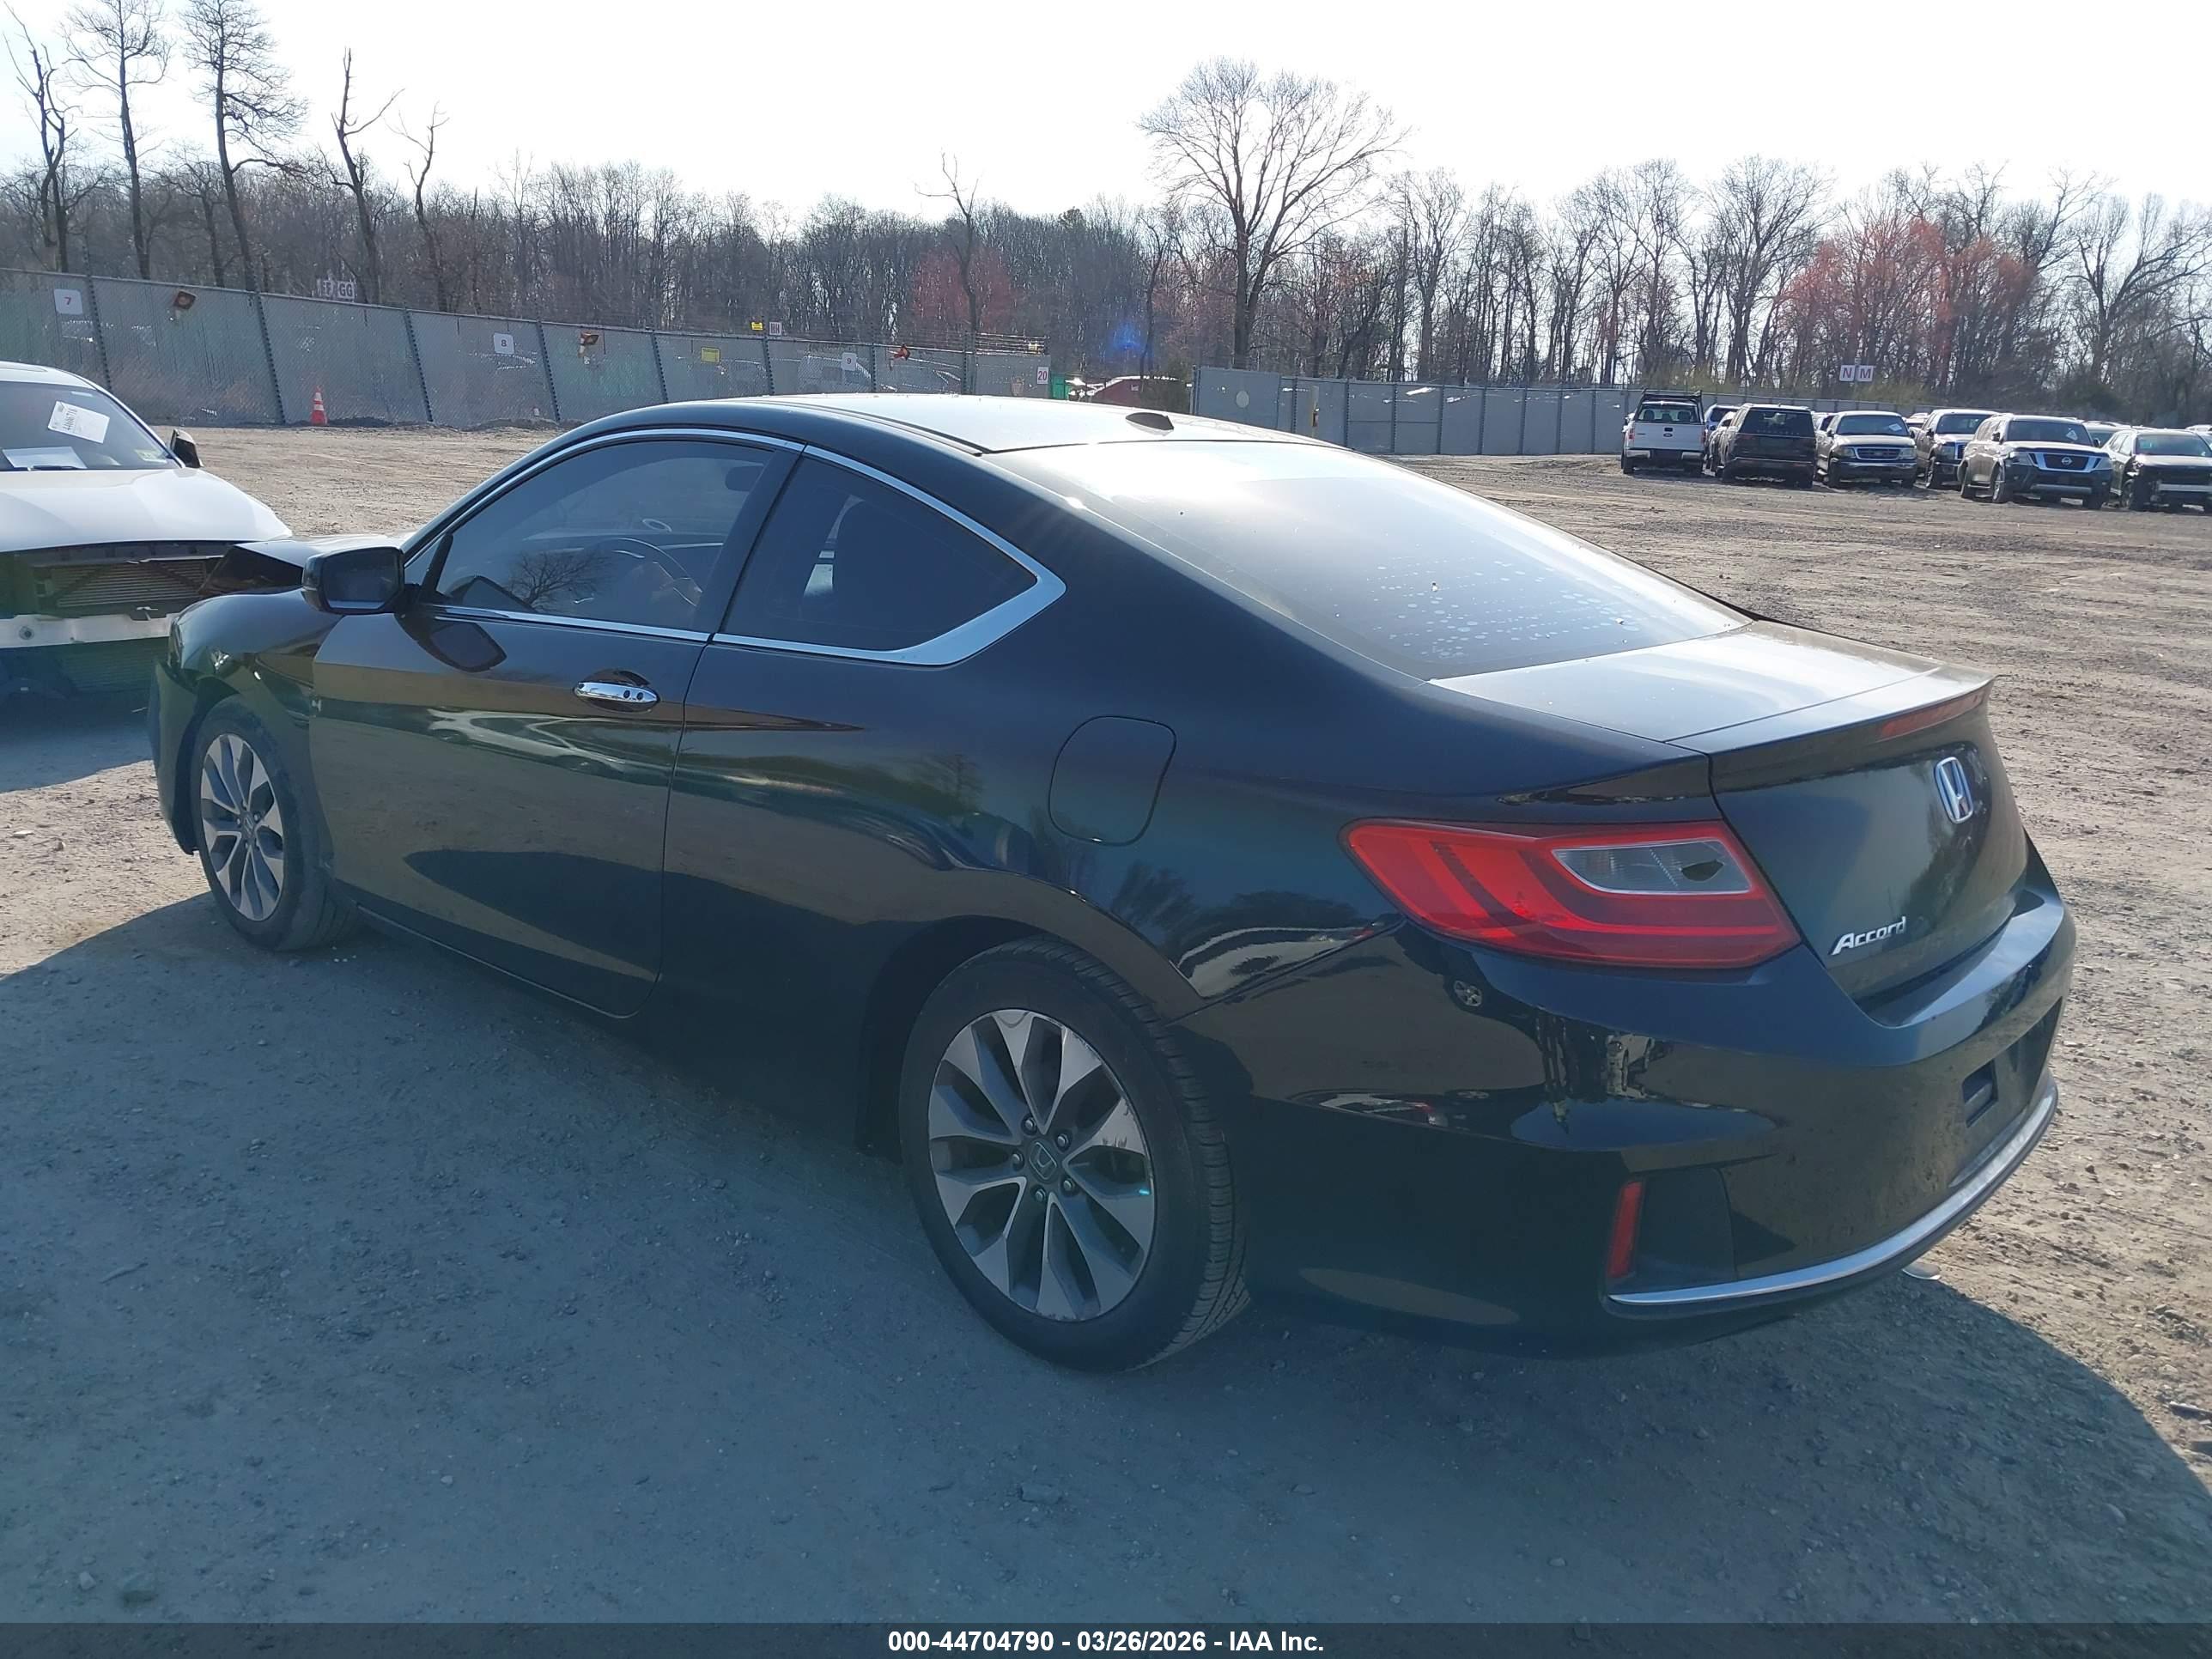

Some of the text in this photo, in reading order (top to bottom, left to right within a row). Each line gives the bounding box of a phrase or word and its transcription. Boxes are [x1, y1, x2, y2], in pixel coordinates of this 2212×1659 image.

[339, 283, 352, 297] GG
[1038, 370, 1048, 380] 20
[1843, 368, 1852, 378] N
[1860, 368, 1871, 379] M
[1831, 915, 1905, 956] Accord
